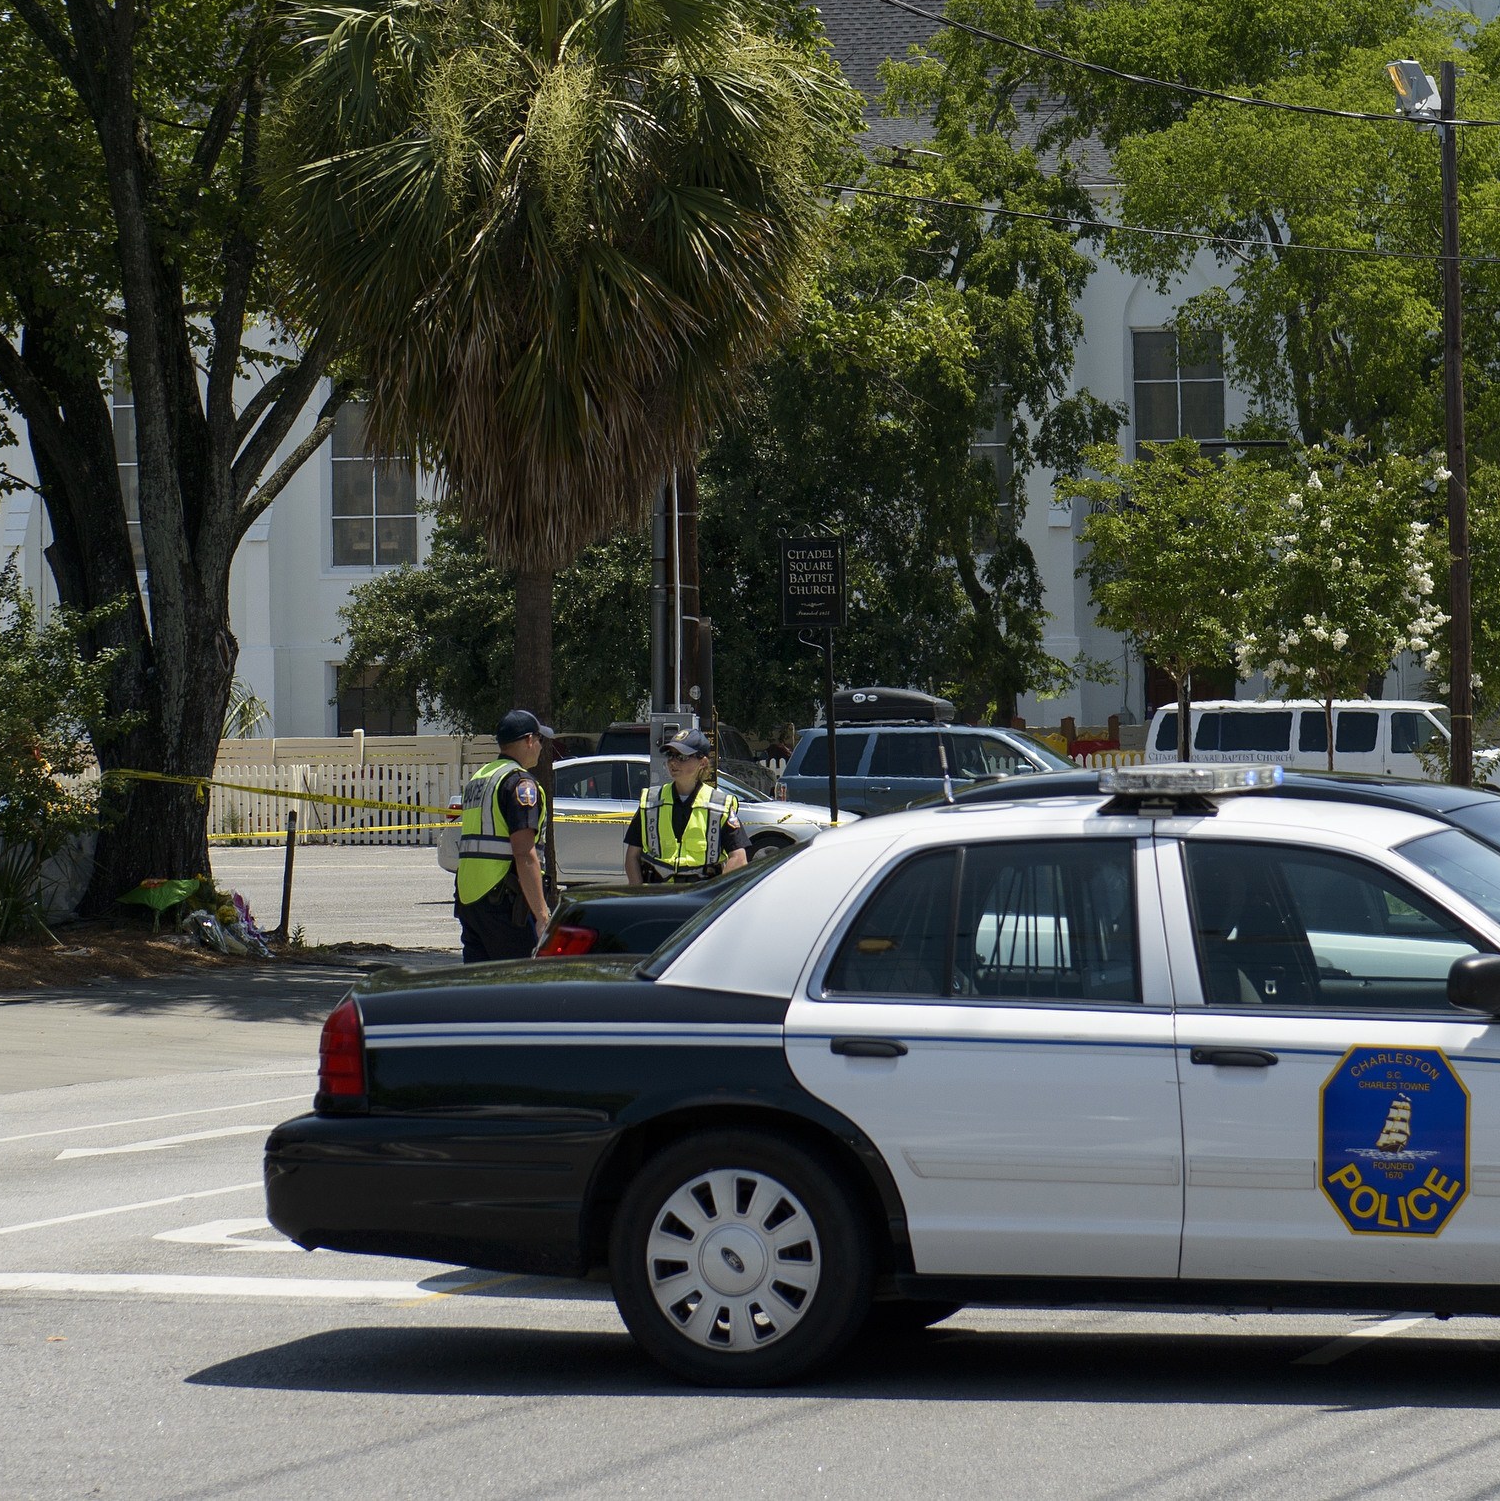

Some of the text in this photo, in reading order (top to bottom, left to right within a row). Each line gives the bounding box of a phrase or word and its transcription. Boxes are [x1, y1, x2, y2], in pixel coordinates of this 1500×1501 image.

[787, 549, 835, 560] CITADEL
[789, 561, 833, 572] SQUARE
[789, 573, 834, 584] BAPTIST
[788, 585, 837, 595] CHURCH
[1192, 753, 1218, 762] QUARE
[1221, 753, 1254, 762] BAPTIST
[1257, 753, 1292, 763] CHURCH
[648, 818, 658, 858] POLIC
[709, 819, 718, 864] POLICE
[1350, 1052, 1441, 1081] CHARLESTON
[1358, 1081, 1430, 1091] CHARLES TOWNE
[1372, 1161, 1415, 1171] FOUNDED
[1384, 1172, 1404, 1180] 1670
[1327, 1162, 1461, 1228] POLICE
